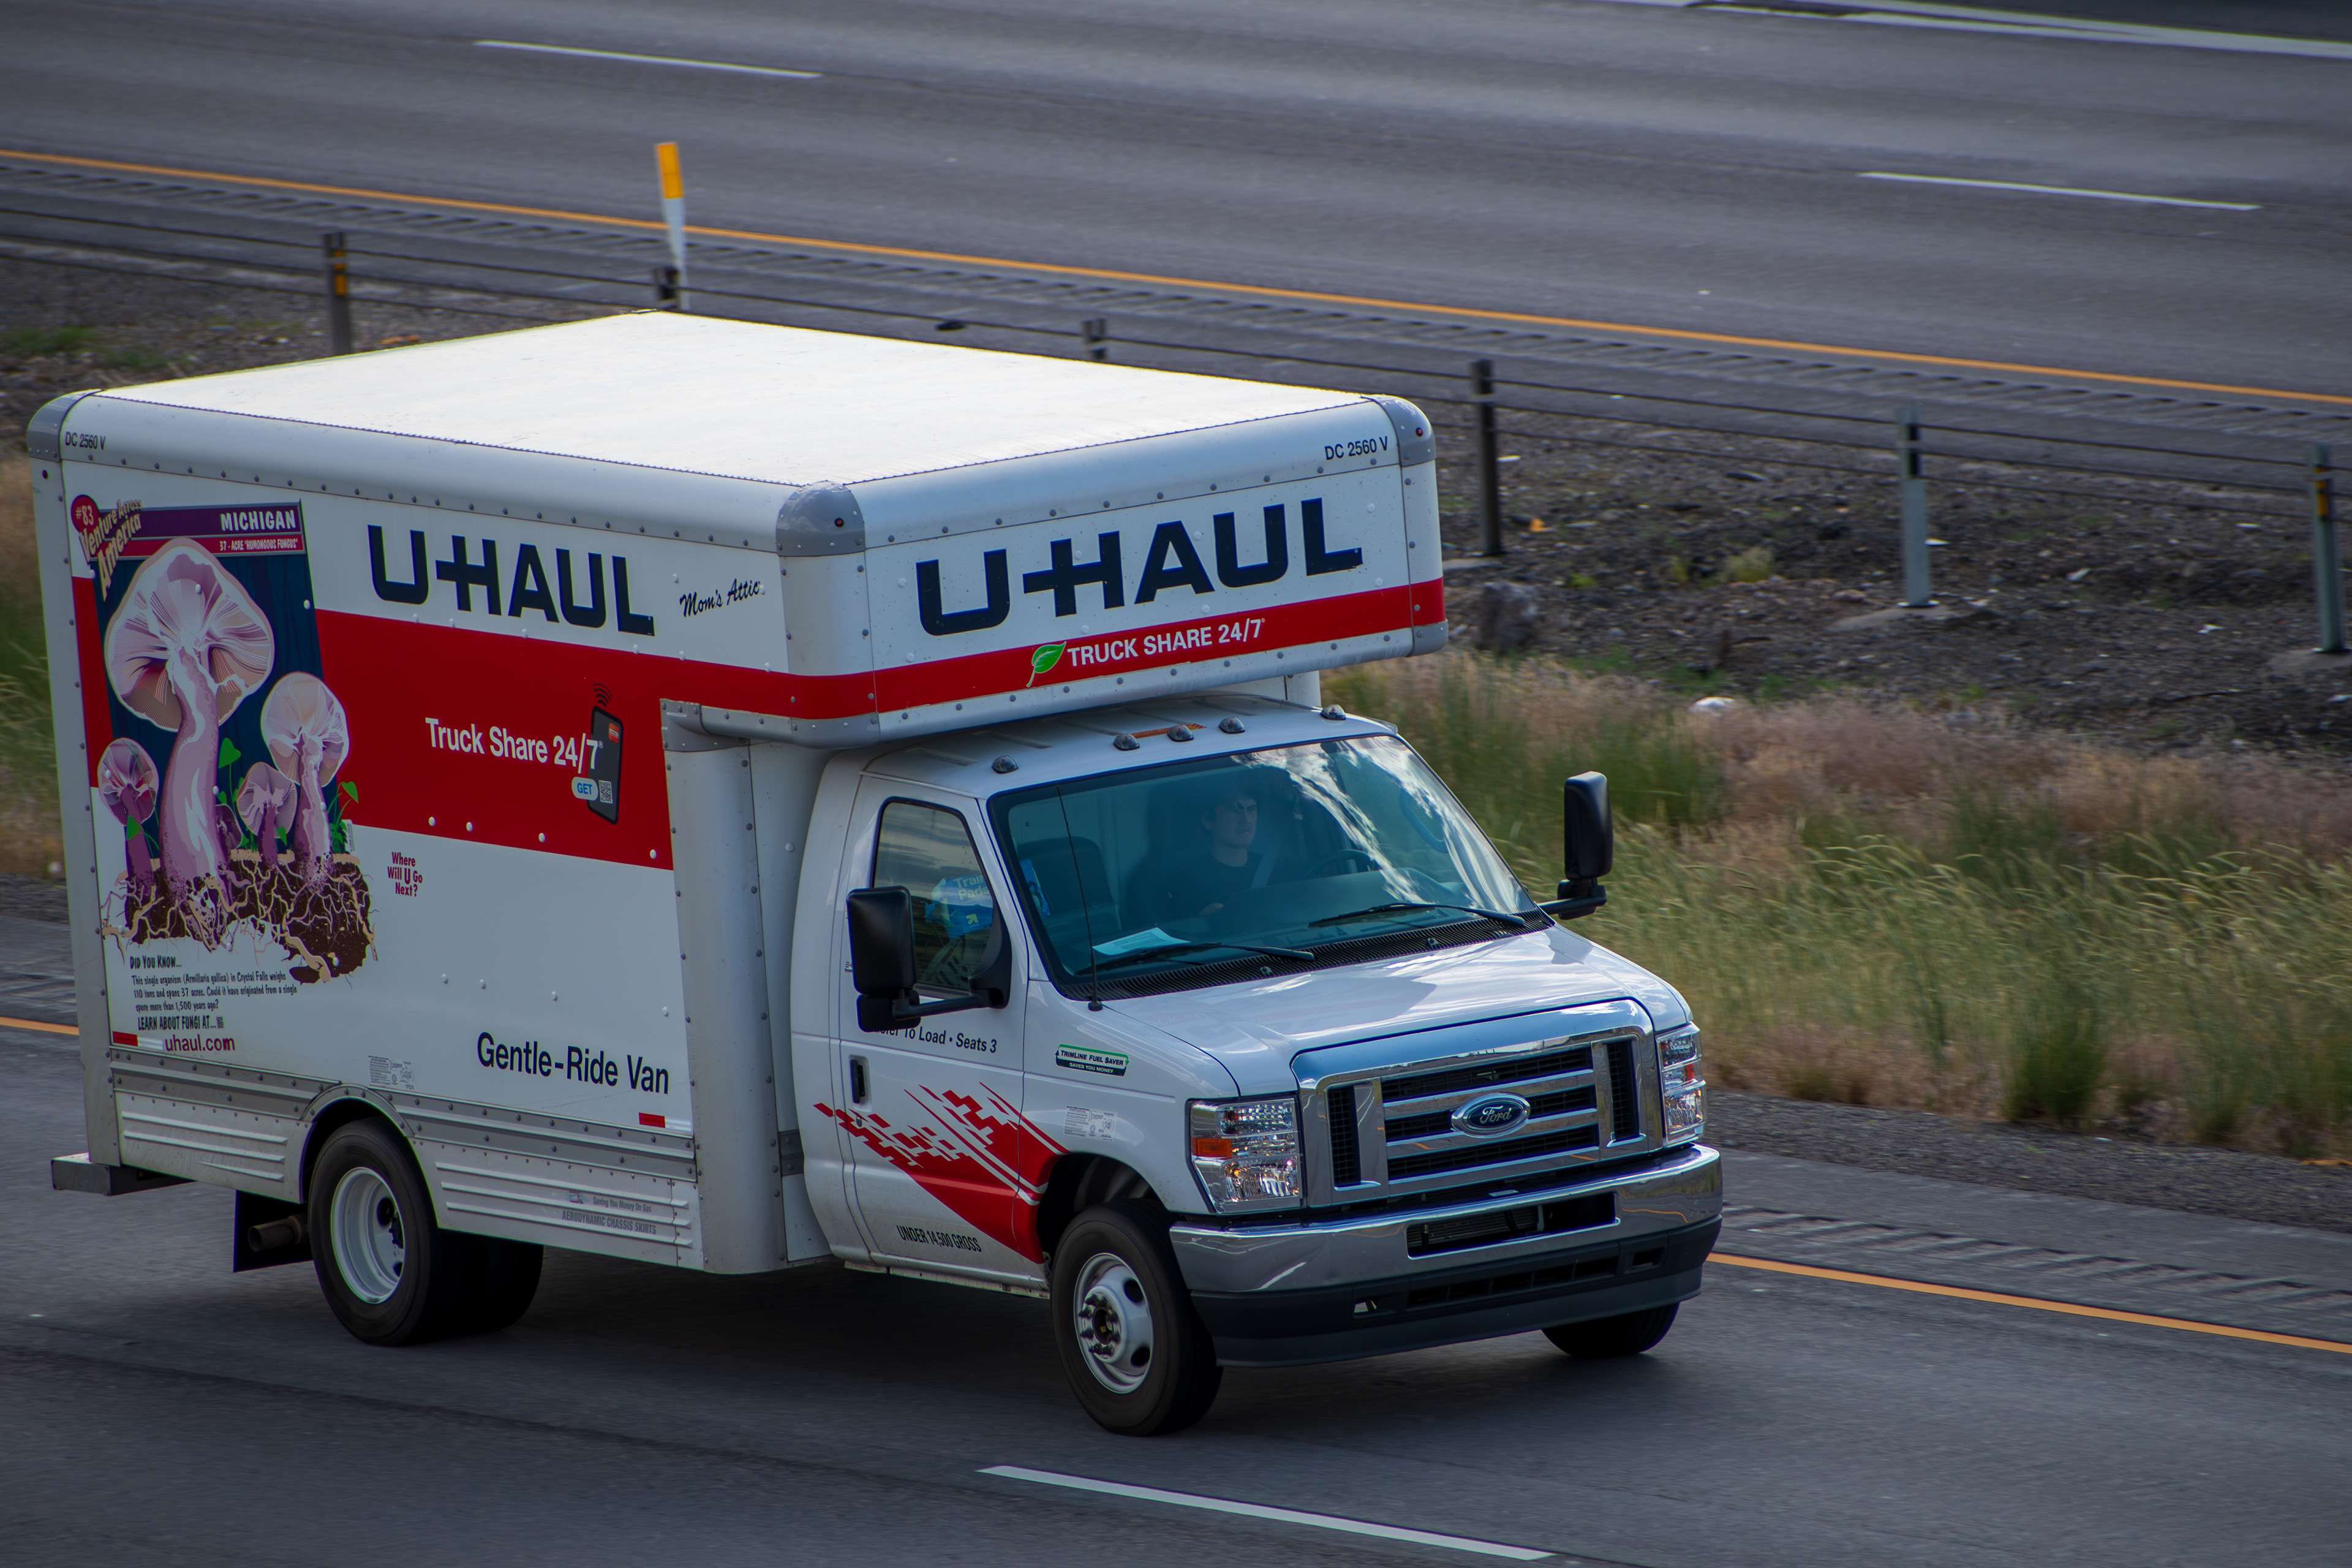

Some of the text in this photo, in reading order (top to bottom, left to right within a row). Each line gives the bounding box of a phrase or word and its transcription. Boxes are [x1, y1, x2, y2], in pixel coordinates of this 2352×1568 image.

[65, 431, 106, 450] DC 2560 V
[1324, 435, 1387, 460] DC 2560 V
[75, 505, 94, 526] #83
[221, 510, 296, 531] MICHIGAN
[79, 499, 143, 564] Venture Across
[219, 541, 227, 551] 37
[232, 540, 244, 551] ACRE
[97, 513, 141, 602] America
[915, 497, 1363, 636] U-HAUL
[367, 524, 655, 636] U-HAUL
[679, 578, 761, 617] Mom's Attic
[1067, 638, 1139, 667] TRUCK
[1144, 626, 1212, 655] SHARE
[425, 717, 485, 755] Truck
[489, 726, 548, 764] Share
[577, 782, 593, 795] GET
[392, 851, 416, 867] Where
[387, 866, 423, 885] Will U Go
[957, 884, 990, 901] Pads
[131, 970, 286, 987] This single organism (Armillaria gallica) in Crystal Falls weighs
[134, 989, 143, 998] 110
[144, 989, 155, 998] tons
[156, 987, 165, 998] and
[166, 989, 180, 1000] spans
[181, 987, 189, 997] 37
[191, 989, 205, 997] acres.
[206, 986, 221, 997] Could
[222, 985, 226, 995] it
[227, 985, 239, 996] have
[240, 984, 264, 997] originated
[265, 984, 277, 995] from
[283, 983, 298, 996] single
[135, 1003, 149, 1014] spore
[163, 1000, 174, 1011] than
[175, 1001, 192, 1012] 1,500
[193, 1002, 206, 1012] years
[207, 998, 219, 1012] ago?
[138, 1014, 216, 1031] LEARN ABOUT FUNGI AT...
[165, 1033, 236, 1052] uhaul.com
[919, 1026, 947, 1045] Load
[956, 1033, 987, 1052] Seats
[990, 1039, 998, 1054] 3
[477, 1031, 669, 1095] Gentle-Ride Van
[1061, 1050, 1088, 1060] TRIMLINE
[1089, 1054, 1103, 1063] FUEL
[1480, 1105, 1512, 1125] Ford
[609, 1199, 618, 1208] You
[619, 1200, 635, 1212] Money
[635, 1202, 642, 1211] On
[643, 1204, 652, 1213] Gas
[562, 1210, 657, 1235] AERODYNAMIC CHASSIS SKIRTS
[896, 1225, 982, 1253] UNDER 14,500 GROSS
